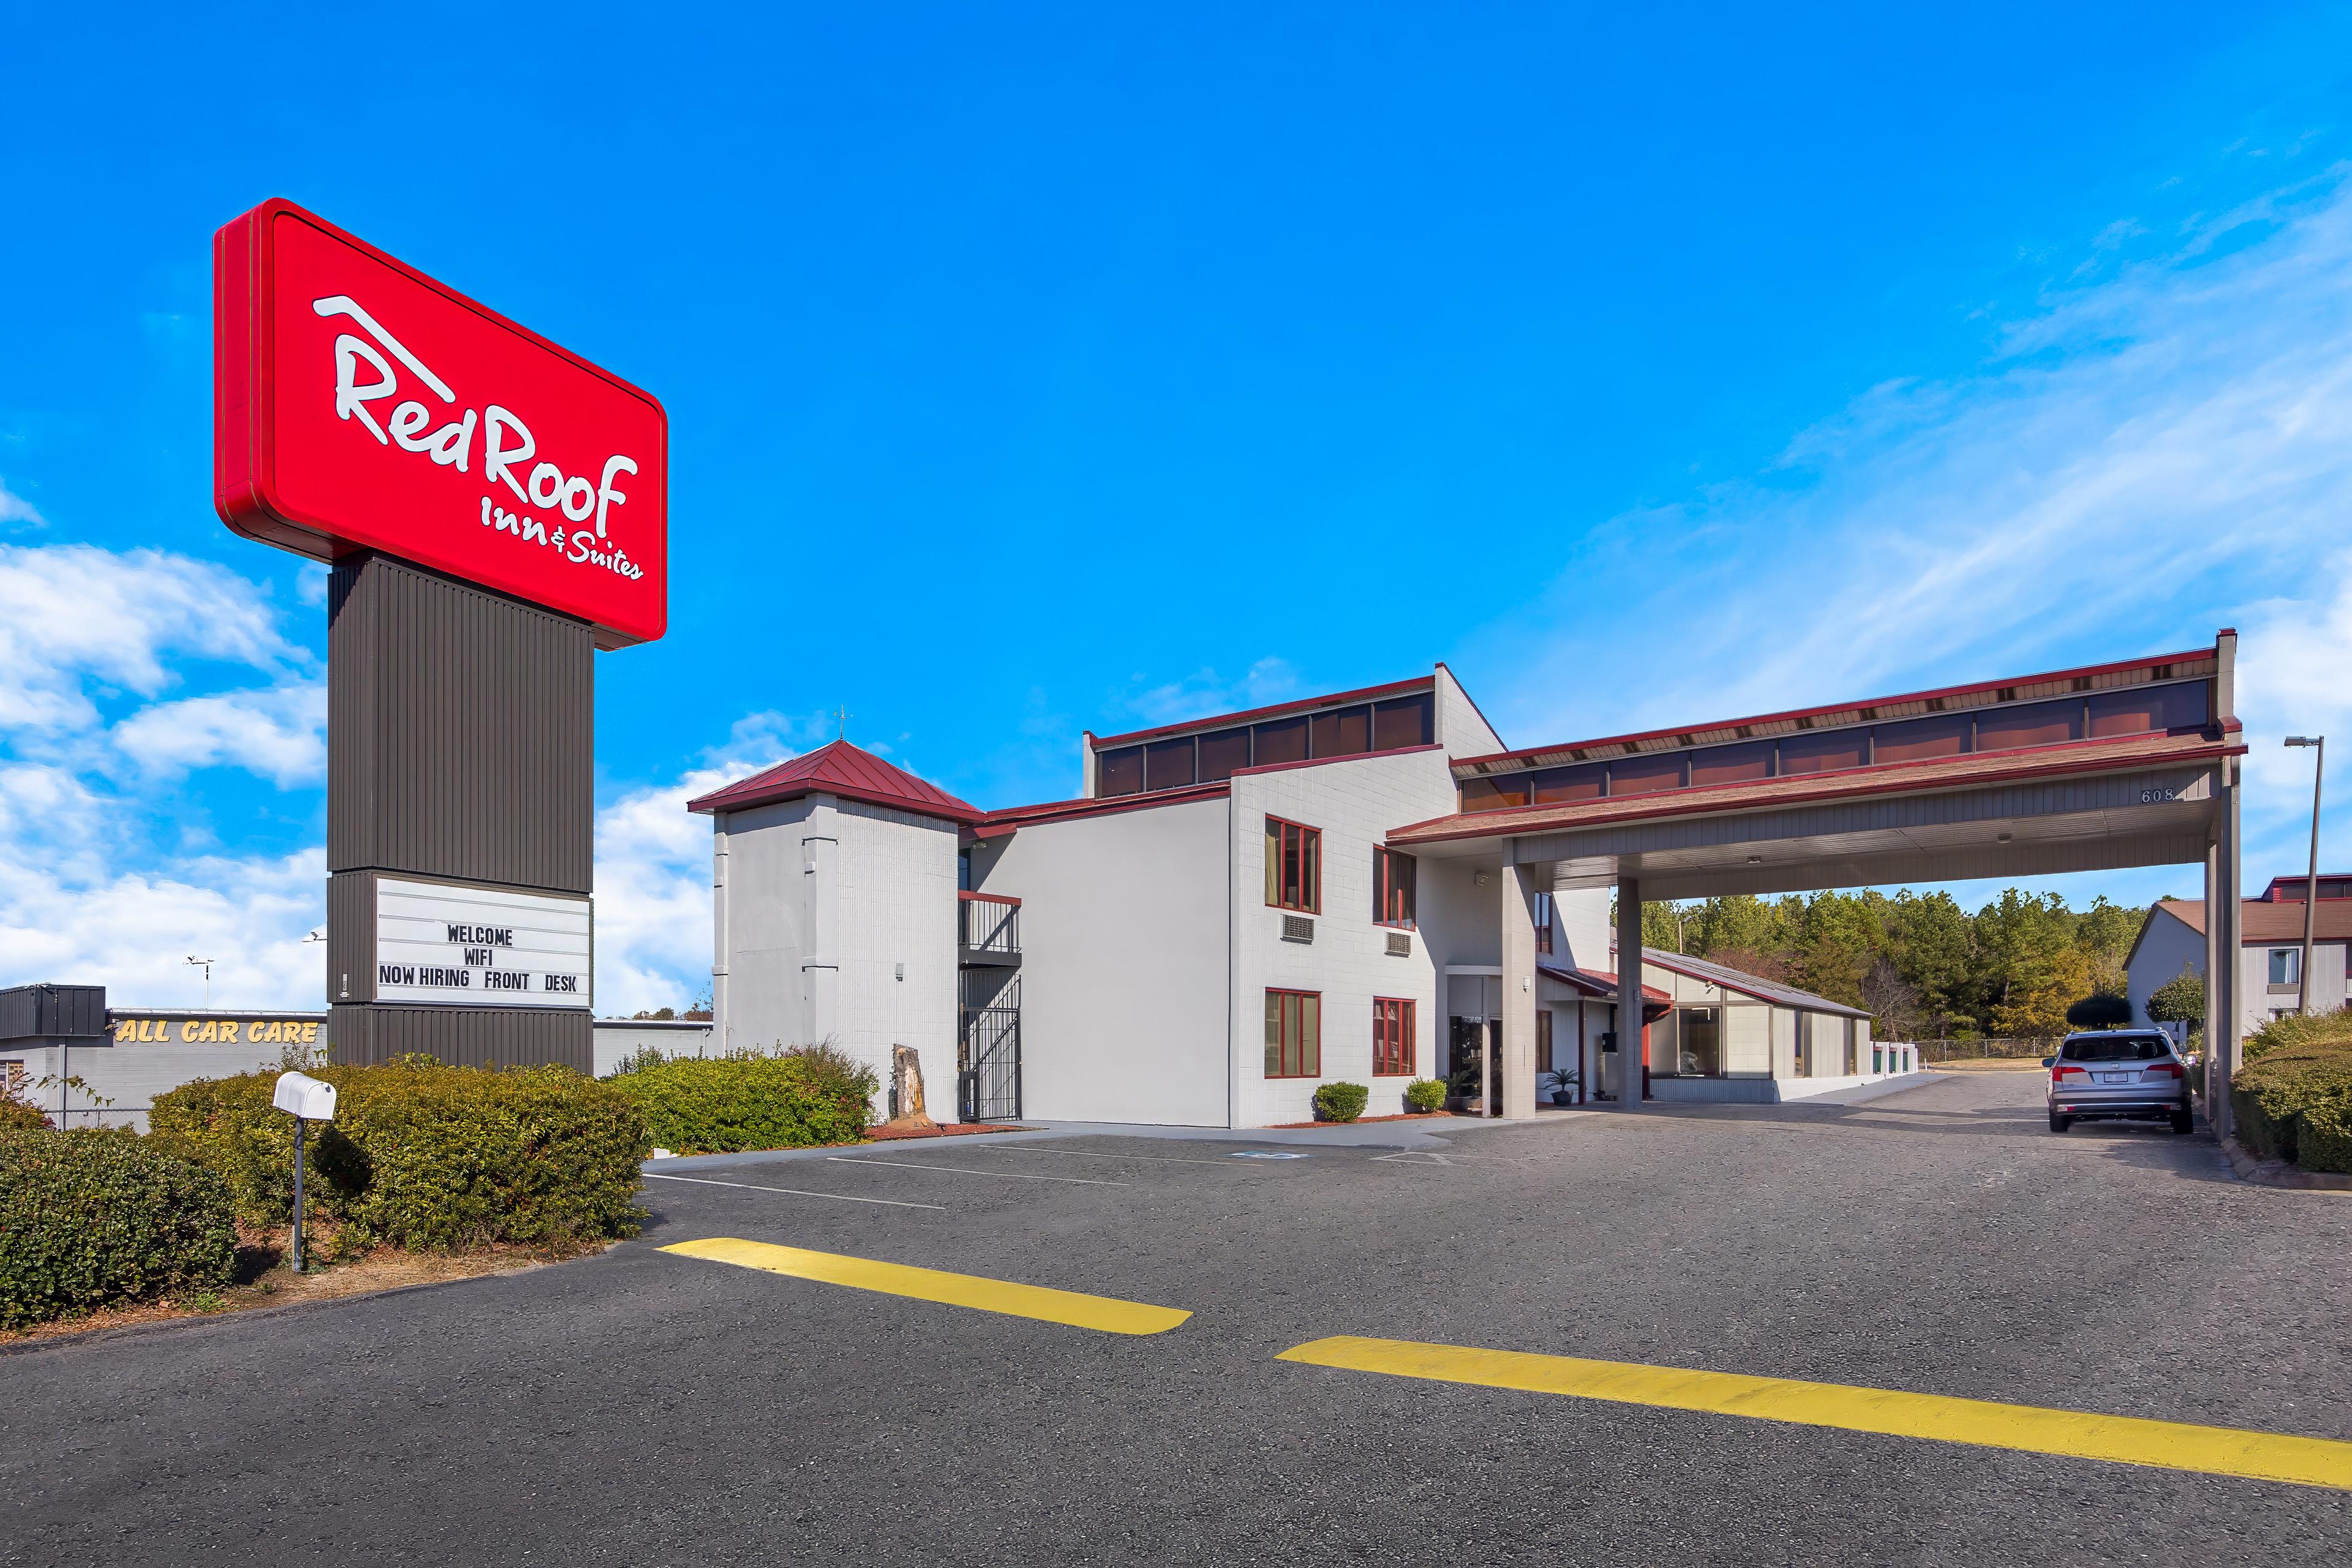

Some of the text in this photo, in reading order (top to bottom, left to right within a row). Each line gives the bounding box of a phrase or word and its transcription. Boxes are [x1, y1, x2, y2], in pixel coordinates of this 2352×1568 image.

[481, 496, 644, 580] Inn & Suites
[2142, 788, 2174, 802] 608
[447, 924, 512, 946] WELCOME
[464, 948, 492, 966] WIFI
[379, 965, 576, 992] NOW HIRING FRONT DESK
[115, 1019, 319, 1044] ALL CAR CARE
